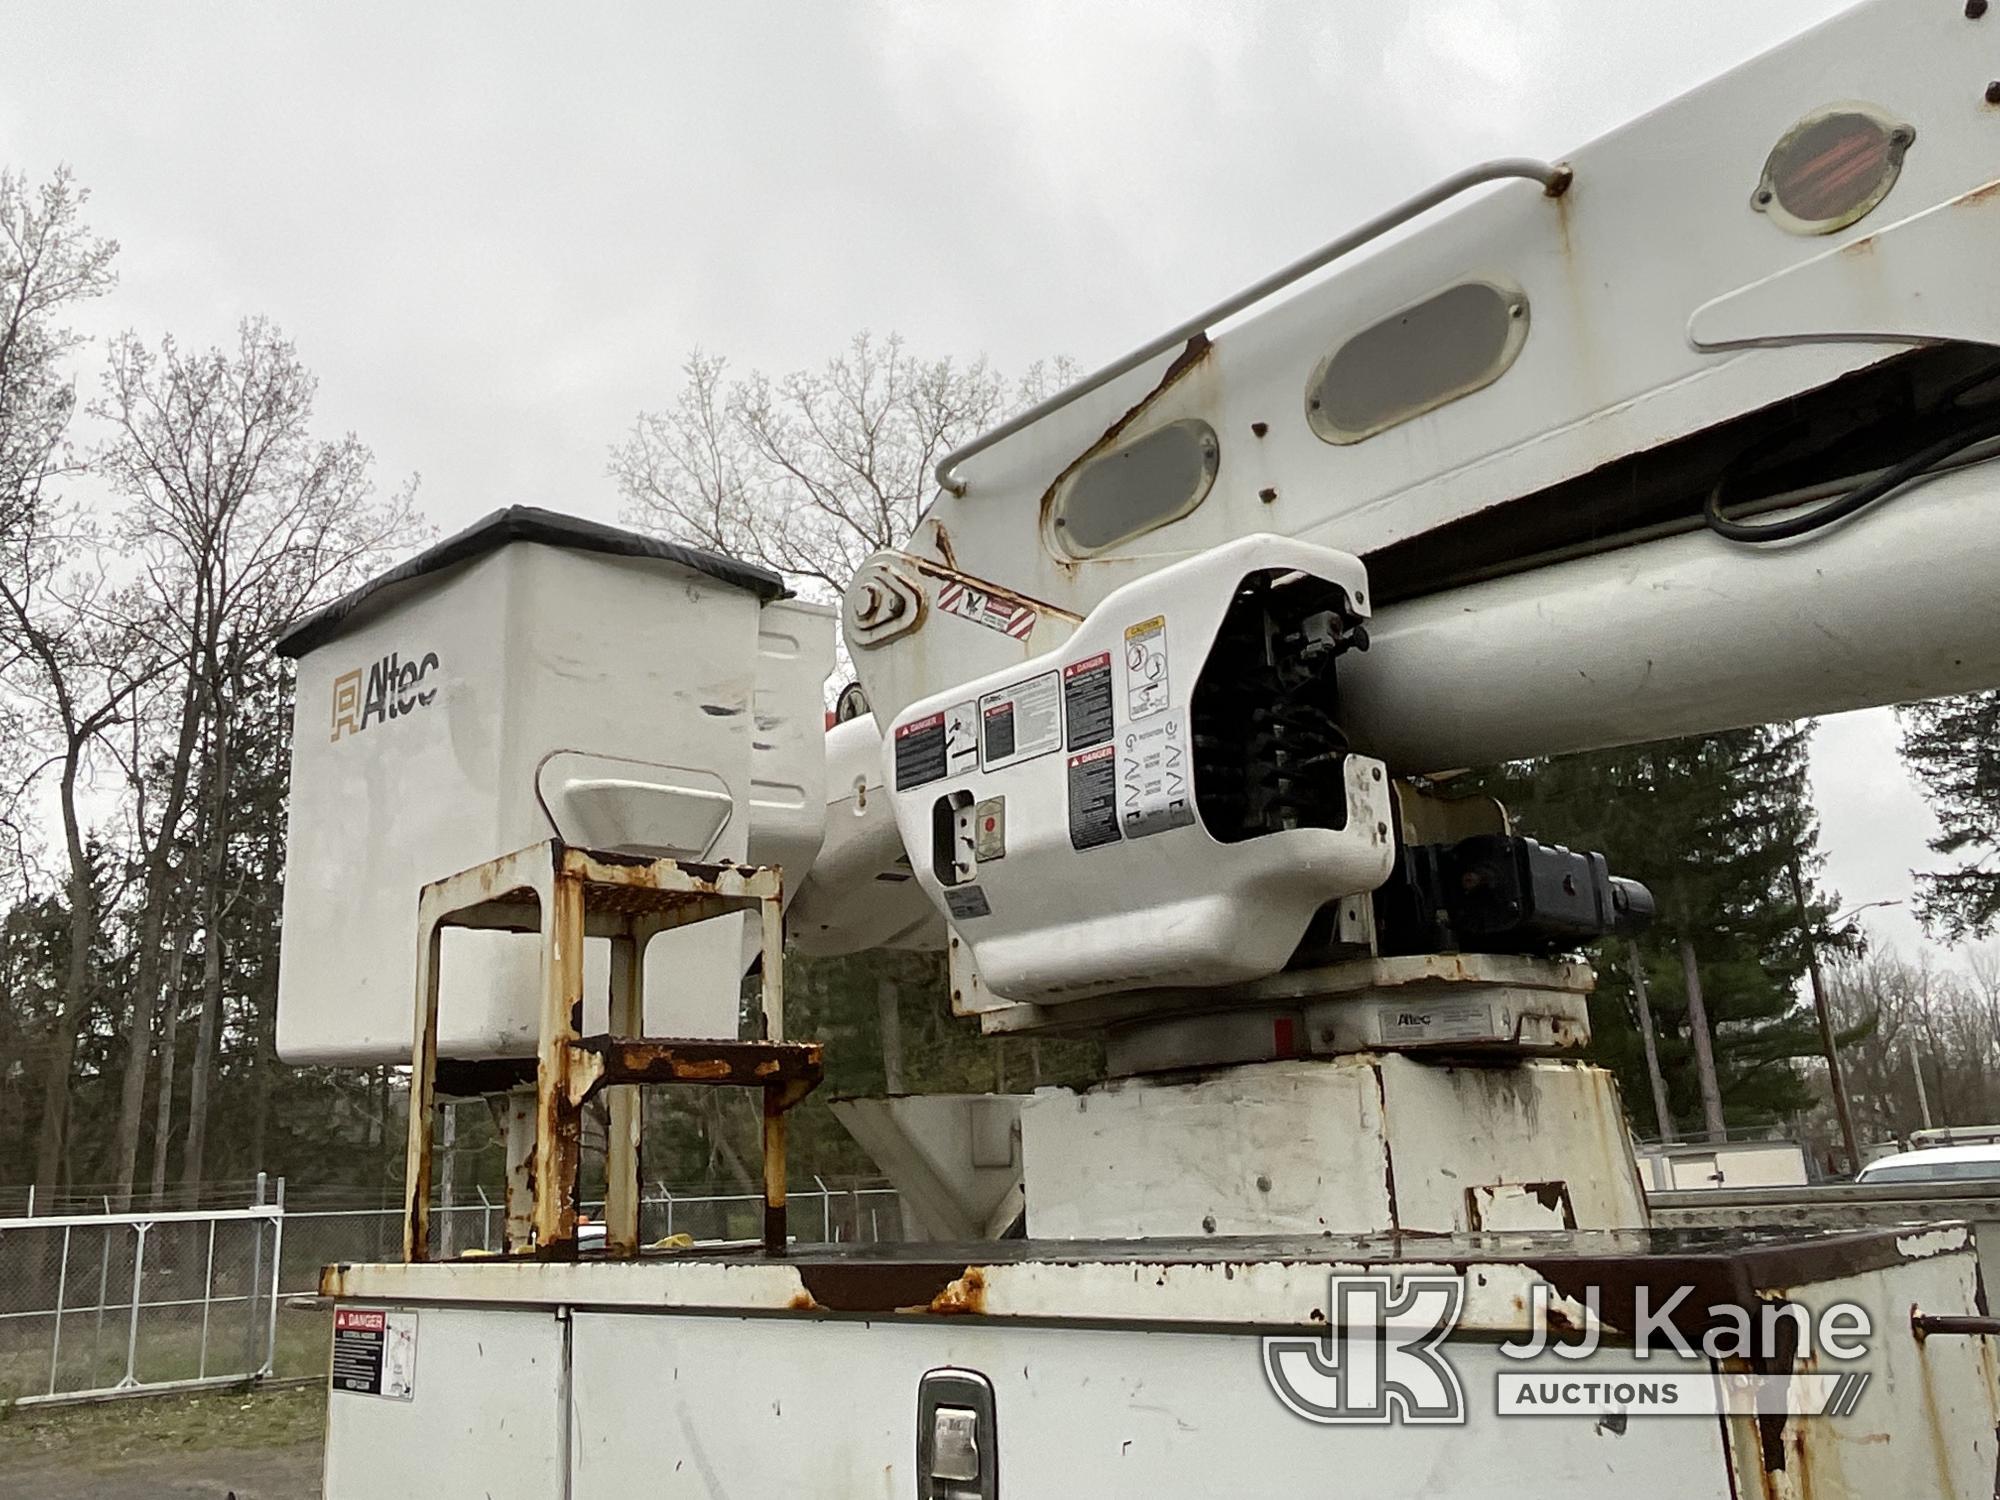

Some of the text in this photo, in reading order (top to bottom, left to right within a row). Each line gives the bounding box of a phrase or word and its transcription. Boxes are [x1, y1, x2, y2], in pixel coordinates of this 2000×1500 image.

[360, 652, 440, 730] Altec
[1082, 748, 1113, 763] DANGER
[348, 1313, 383, 1328] DANGER
